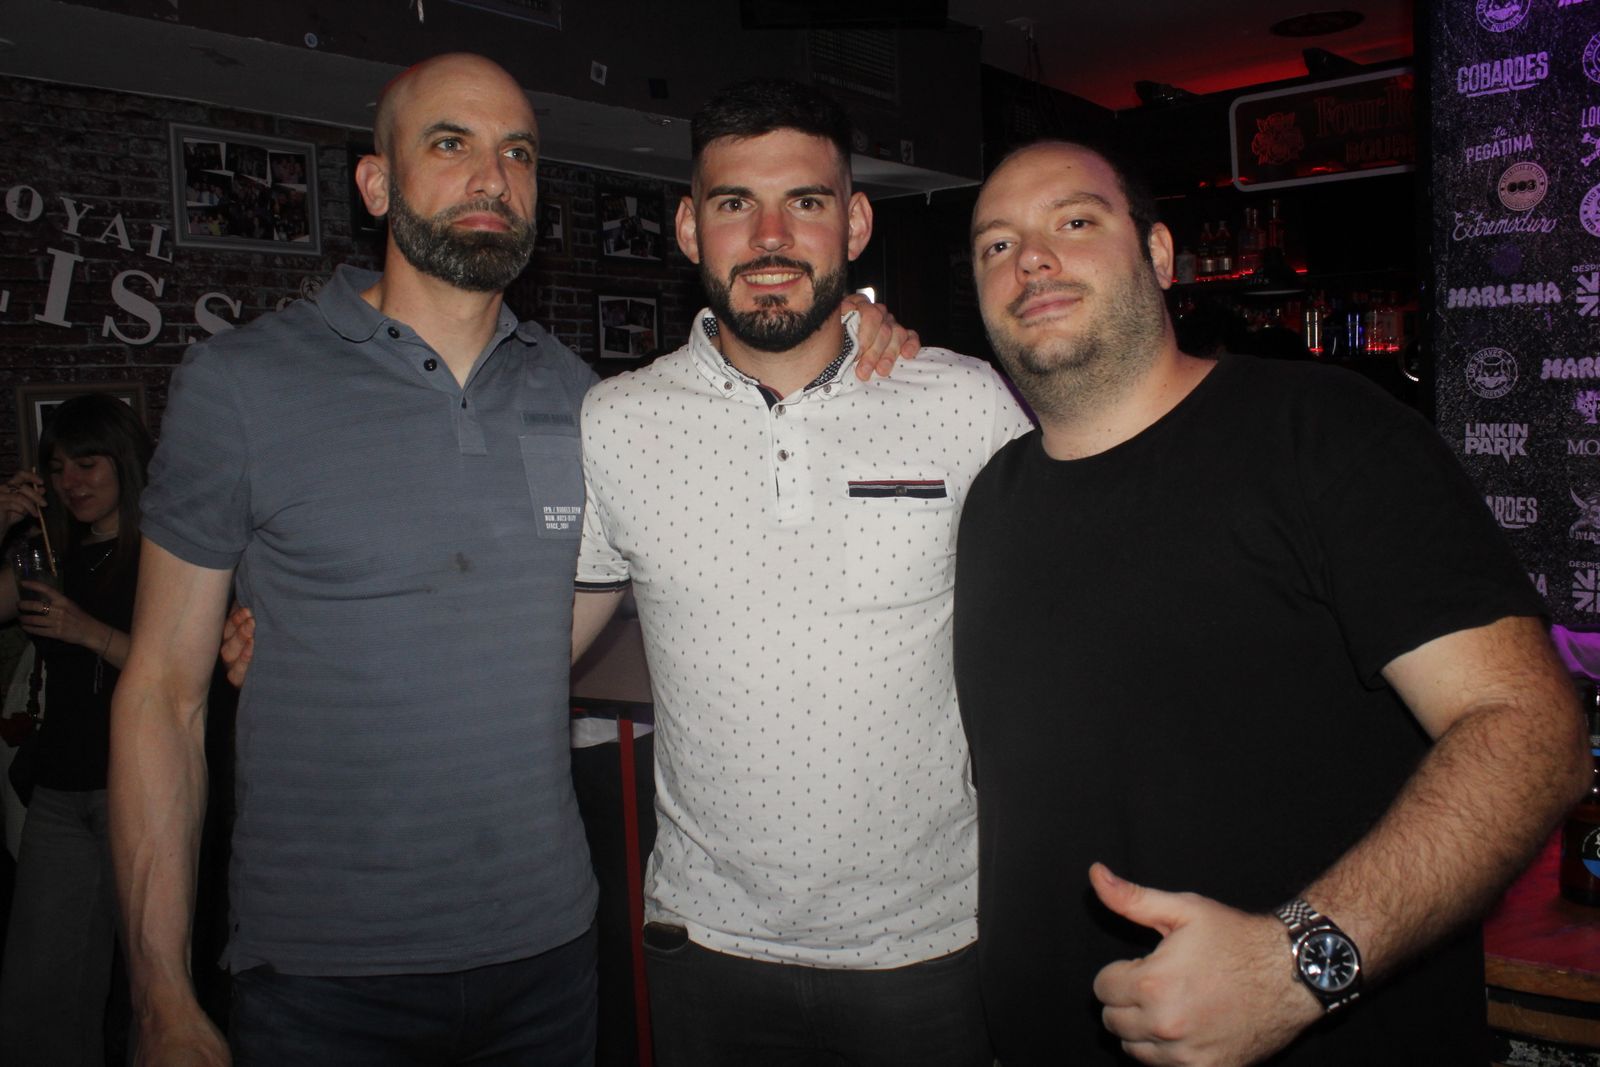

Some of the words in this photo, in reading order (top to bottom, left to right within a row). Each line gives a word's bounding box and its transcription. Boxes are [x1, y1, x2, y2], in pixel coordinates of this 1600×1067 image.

[1457, 51, 1549, 96] COBARDES
[1466, 134, 1534, 163] PEGATINA
[1452, 208, 1557, 241] Extremoduro
[1447, 282, 1561, 308] MARLENA
[1465, 423, 1529, 439] LINKIN
[1465, 438, 1527, 463] PARK
